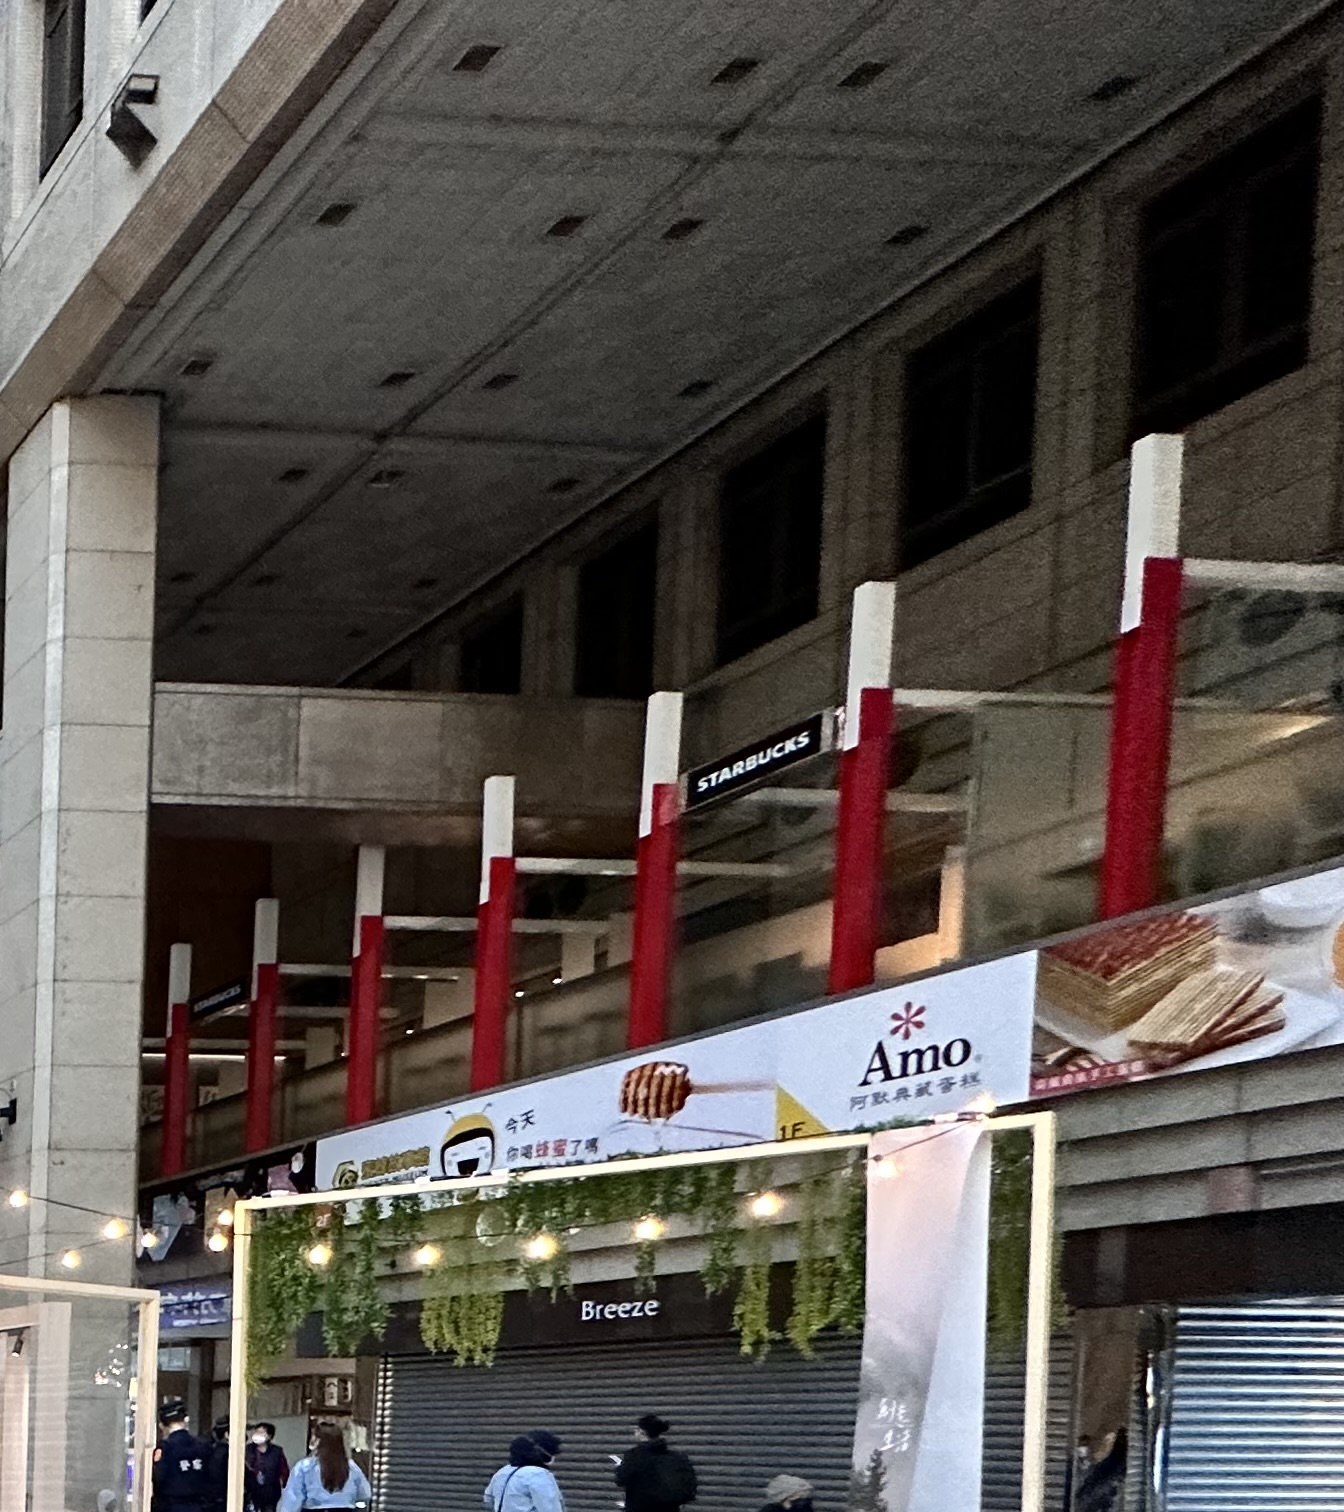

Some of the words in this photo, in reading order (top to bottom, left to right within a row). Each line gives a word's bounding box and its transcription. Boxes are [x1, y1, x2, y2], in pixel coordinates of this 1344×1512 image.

[696, 731, 811, 792] STARBUCKS
[857, 1038, 972, 1087] Amo
[505, 1109, 535, 1134] 今天
[779, 1121, 806, 1140] 1F
[581, 1299, 661, 1320] Breeze
